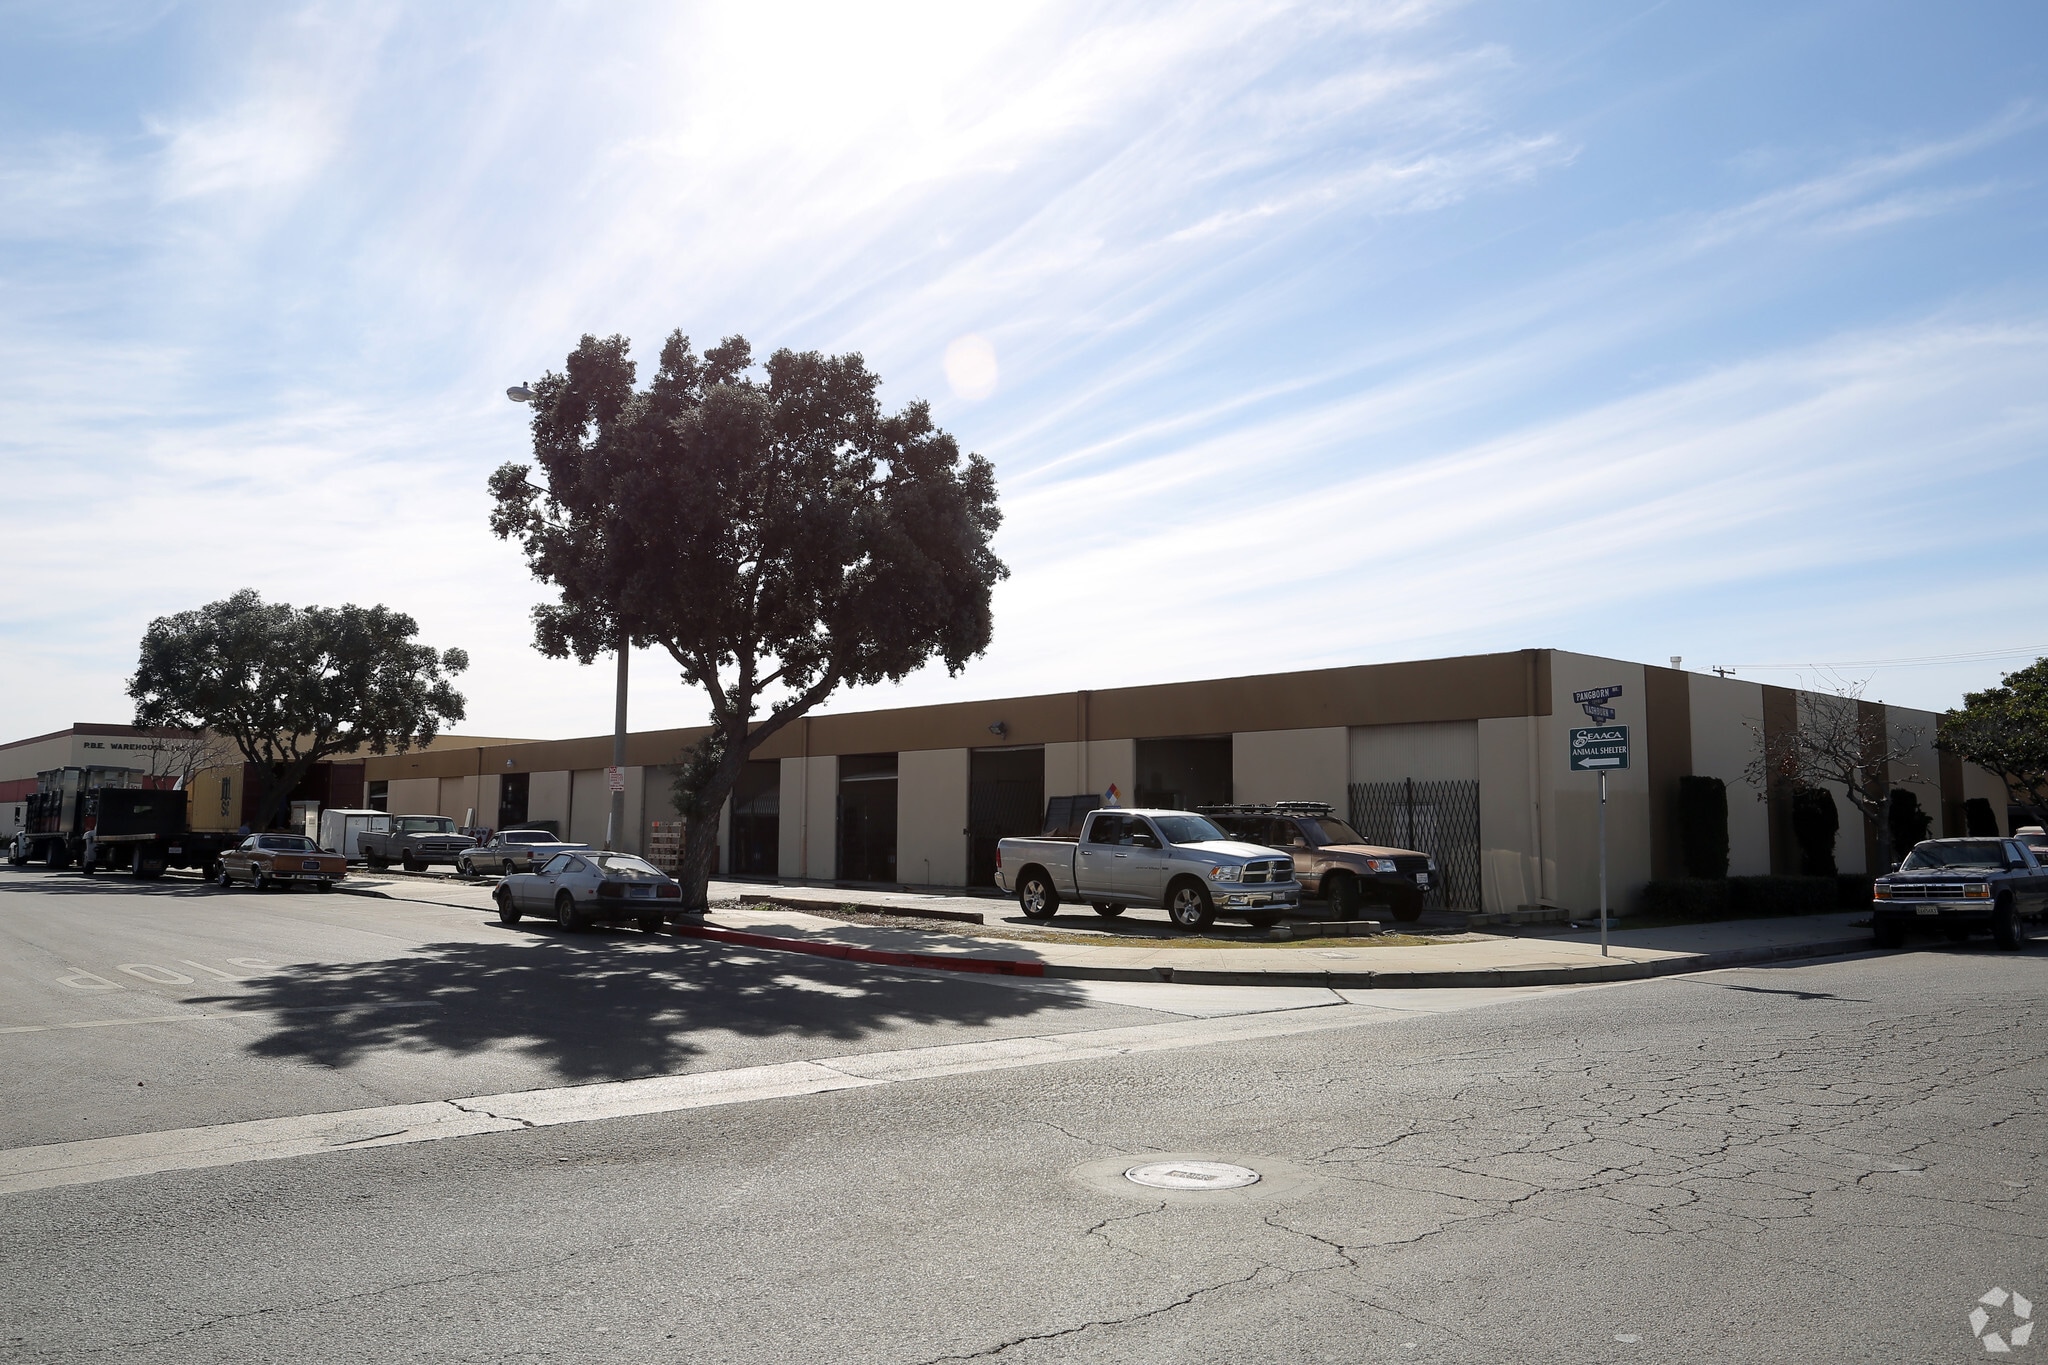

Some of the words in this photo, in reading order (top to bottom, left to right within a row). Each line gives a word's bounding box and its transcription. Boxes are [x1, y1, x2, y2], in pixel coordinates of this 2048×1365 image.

[1576, 688, 1609, 702] PANGBORN
[1572, 730, 1622, 747] SEAACA
[110, 743, 166, 751] WAREHOUSE
[1572, 747, 1599, 756] ANIMAL
[1599, 745, 1627, 755] SHELTER
[56, 957, 287, 990] STOP
